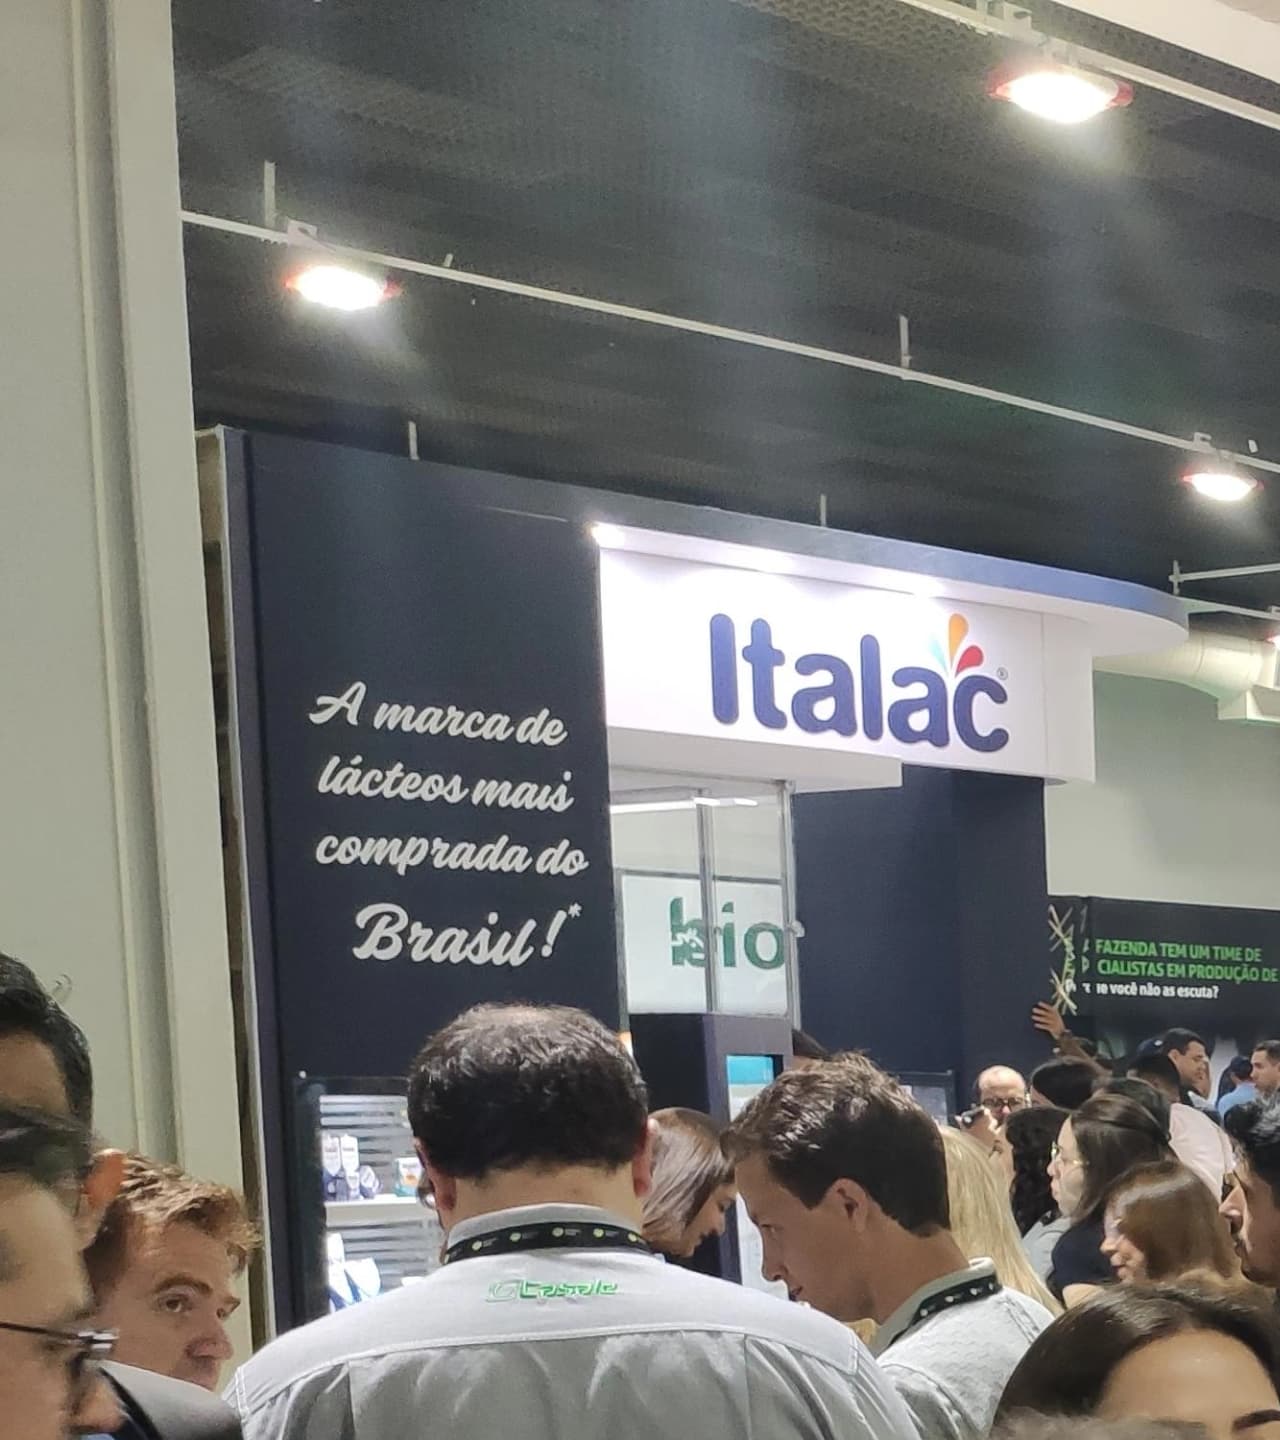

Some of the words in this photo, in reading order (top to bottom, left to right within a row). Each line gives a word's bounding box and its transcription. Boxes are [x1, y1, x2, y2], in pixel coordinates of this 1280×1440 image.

[709, 612, 1009, 753] Italac
[309, 681, 367, 725] A
[373, 702, 514, 741] marca
[516, 708, 568, 746] de
[318, 755, 468, 803] lácteos
[471, 771, 574, 812] mais
[316, 835, 533, 876] comprada
[536, 839, 589, 876] do
[670, 897, 786, 969] bio
[1095, 939, 1157, 957] FAZENDA
[1160, 942, 1187, 958] TEM
[1189, 944, 1210, 960] UM
[1212, 945, 1242, 961] TIME
[1244, 948, 1262, 963] DE
[1110, 982, 1137, 996] você
[1139, 982, 1161, 997] não
[1163, 986, 1175, 998] as
[1177, 984, 1219, 999] escuta?
[1167, 963, 1186, 978] EM
[1188, 962, 1259, 985] PRODUÇÃO
[1262, 967, 1279, 982] DE
